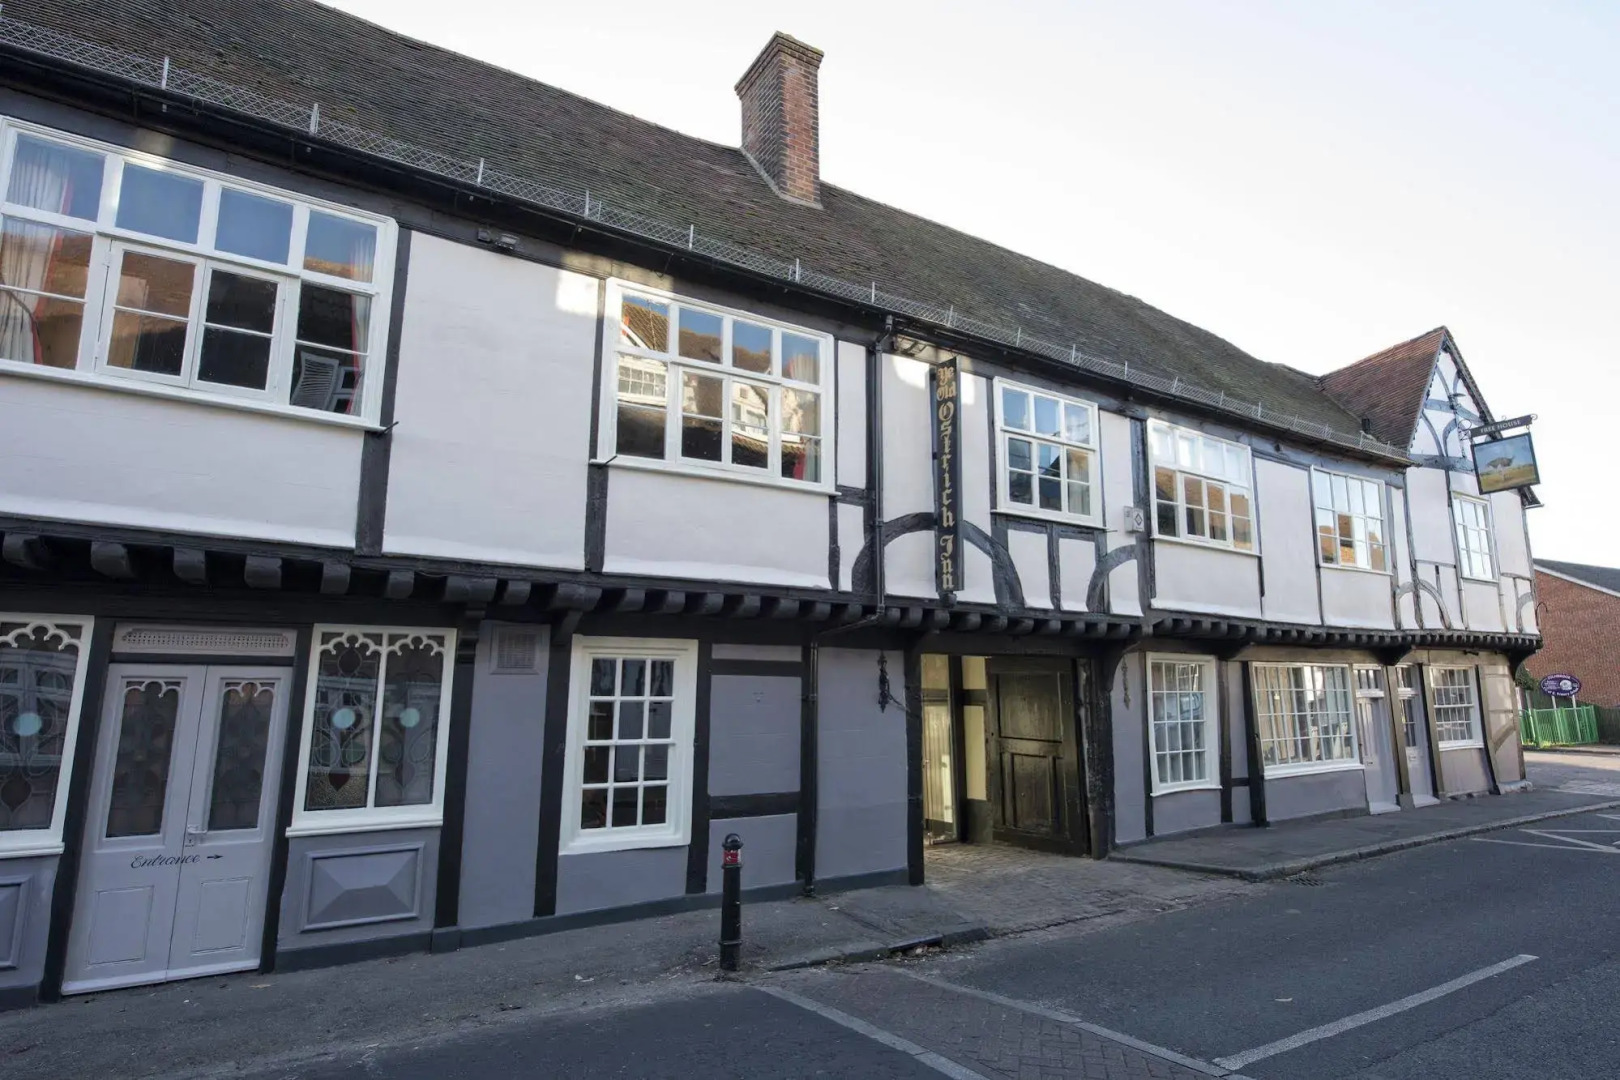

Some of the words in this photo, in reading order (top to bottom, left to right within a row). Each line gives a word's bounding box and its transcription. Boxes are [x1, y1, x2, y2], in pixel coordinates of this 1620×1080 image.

[936, 381, 957, 401] Old
[1480, 425, 1496, 434] FREE
[1497, 420, 1521, 430] HOUSE
[938, 401, 955, 529] Ostrich
[940, 534, 955, 590] Inn
[130, 854, 201, 869] Entrance
